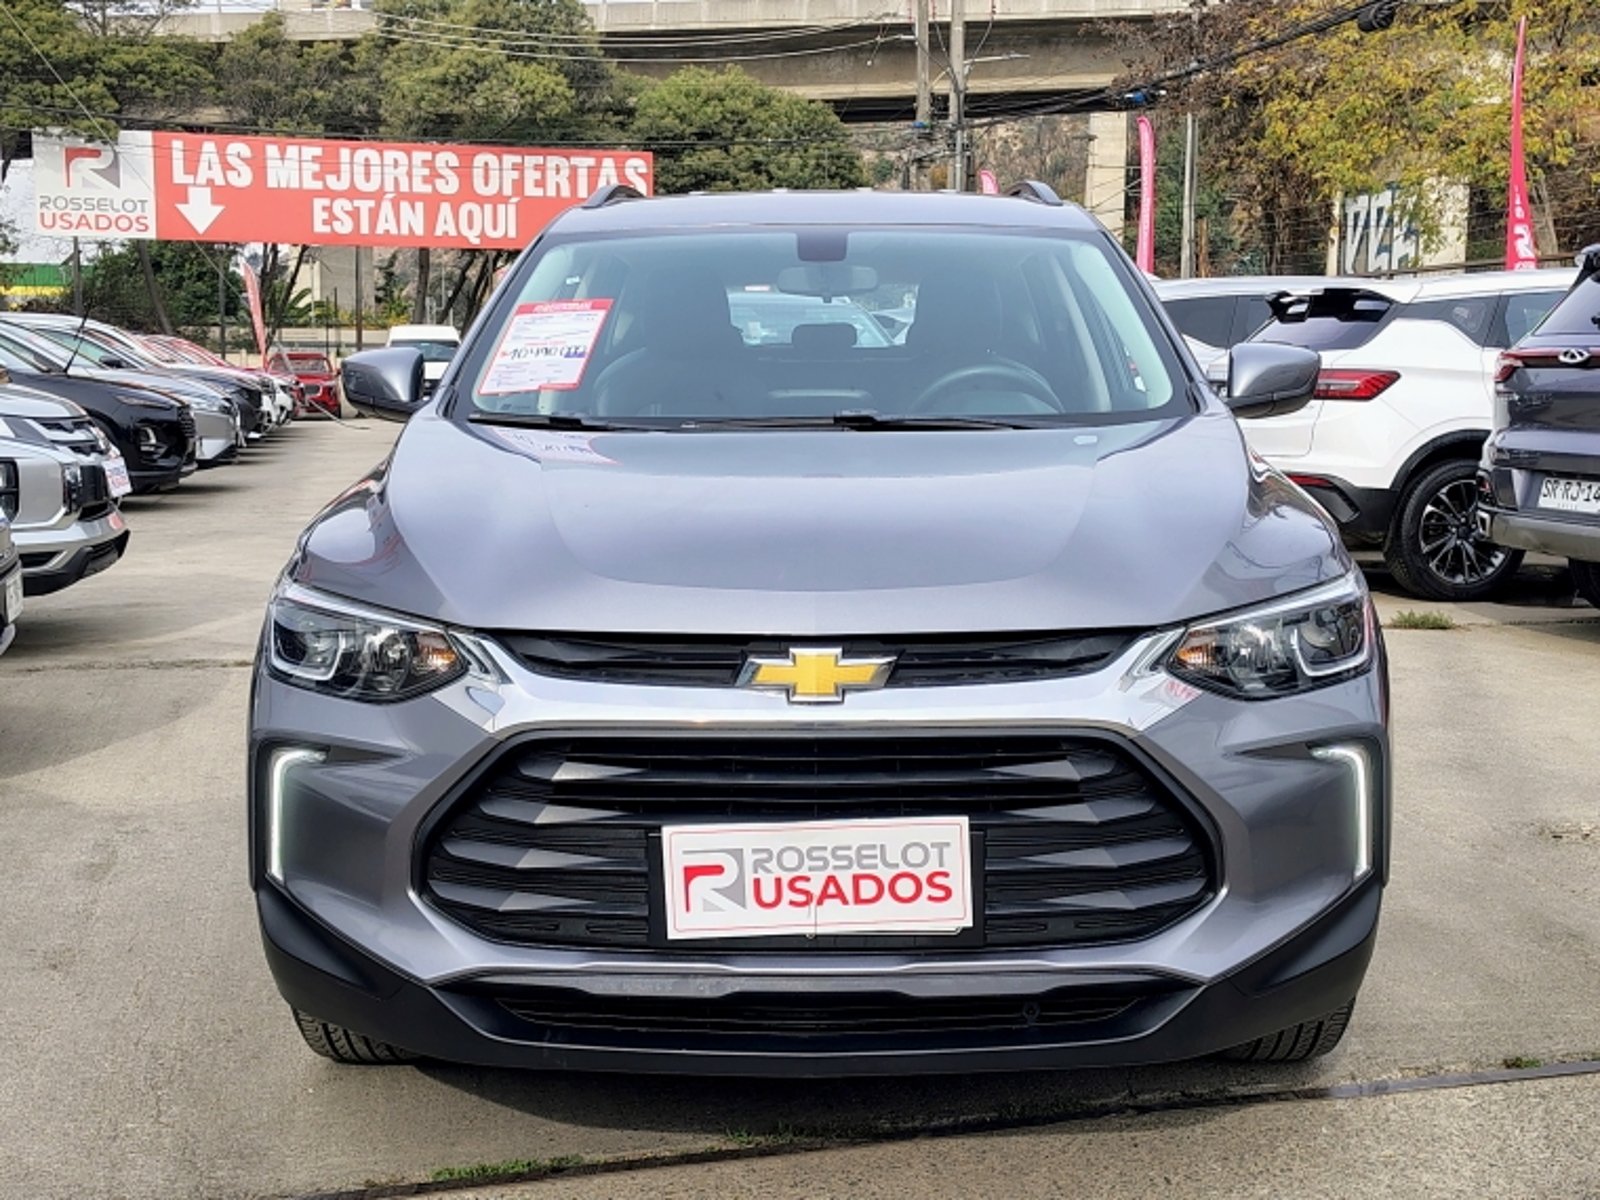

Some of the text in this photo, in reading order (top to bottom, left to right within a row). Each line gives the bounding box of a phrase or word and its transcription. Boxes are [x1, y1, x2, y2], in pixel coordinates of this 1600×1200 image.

[171, 138, 649, 198] LAS MEJORES OFERTAS
[39, 195, 148, 214] ROSSELOT
[40, 212, 149, 233] USADOS
[312, 193, 521, 245] ESTÁN AQUÍ
[751, 841, 951, 875] ROSSELOT
[752, 870, 954, 910] USADOS
